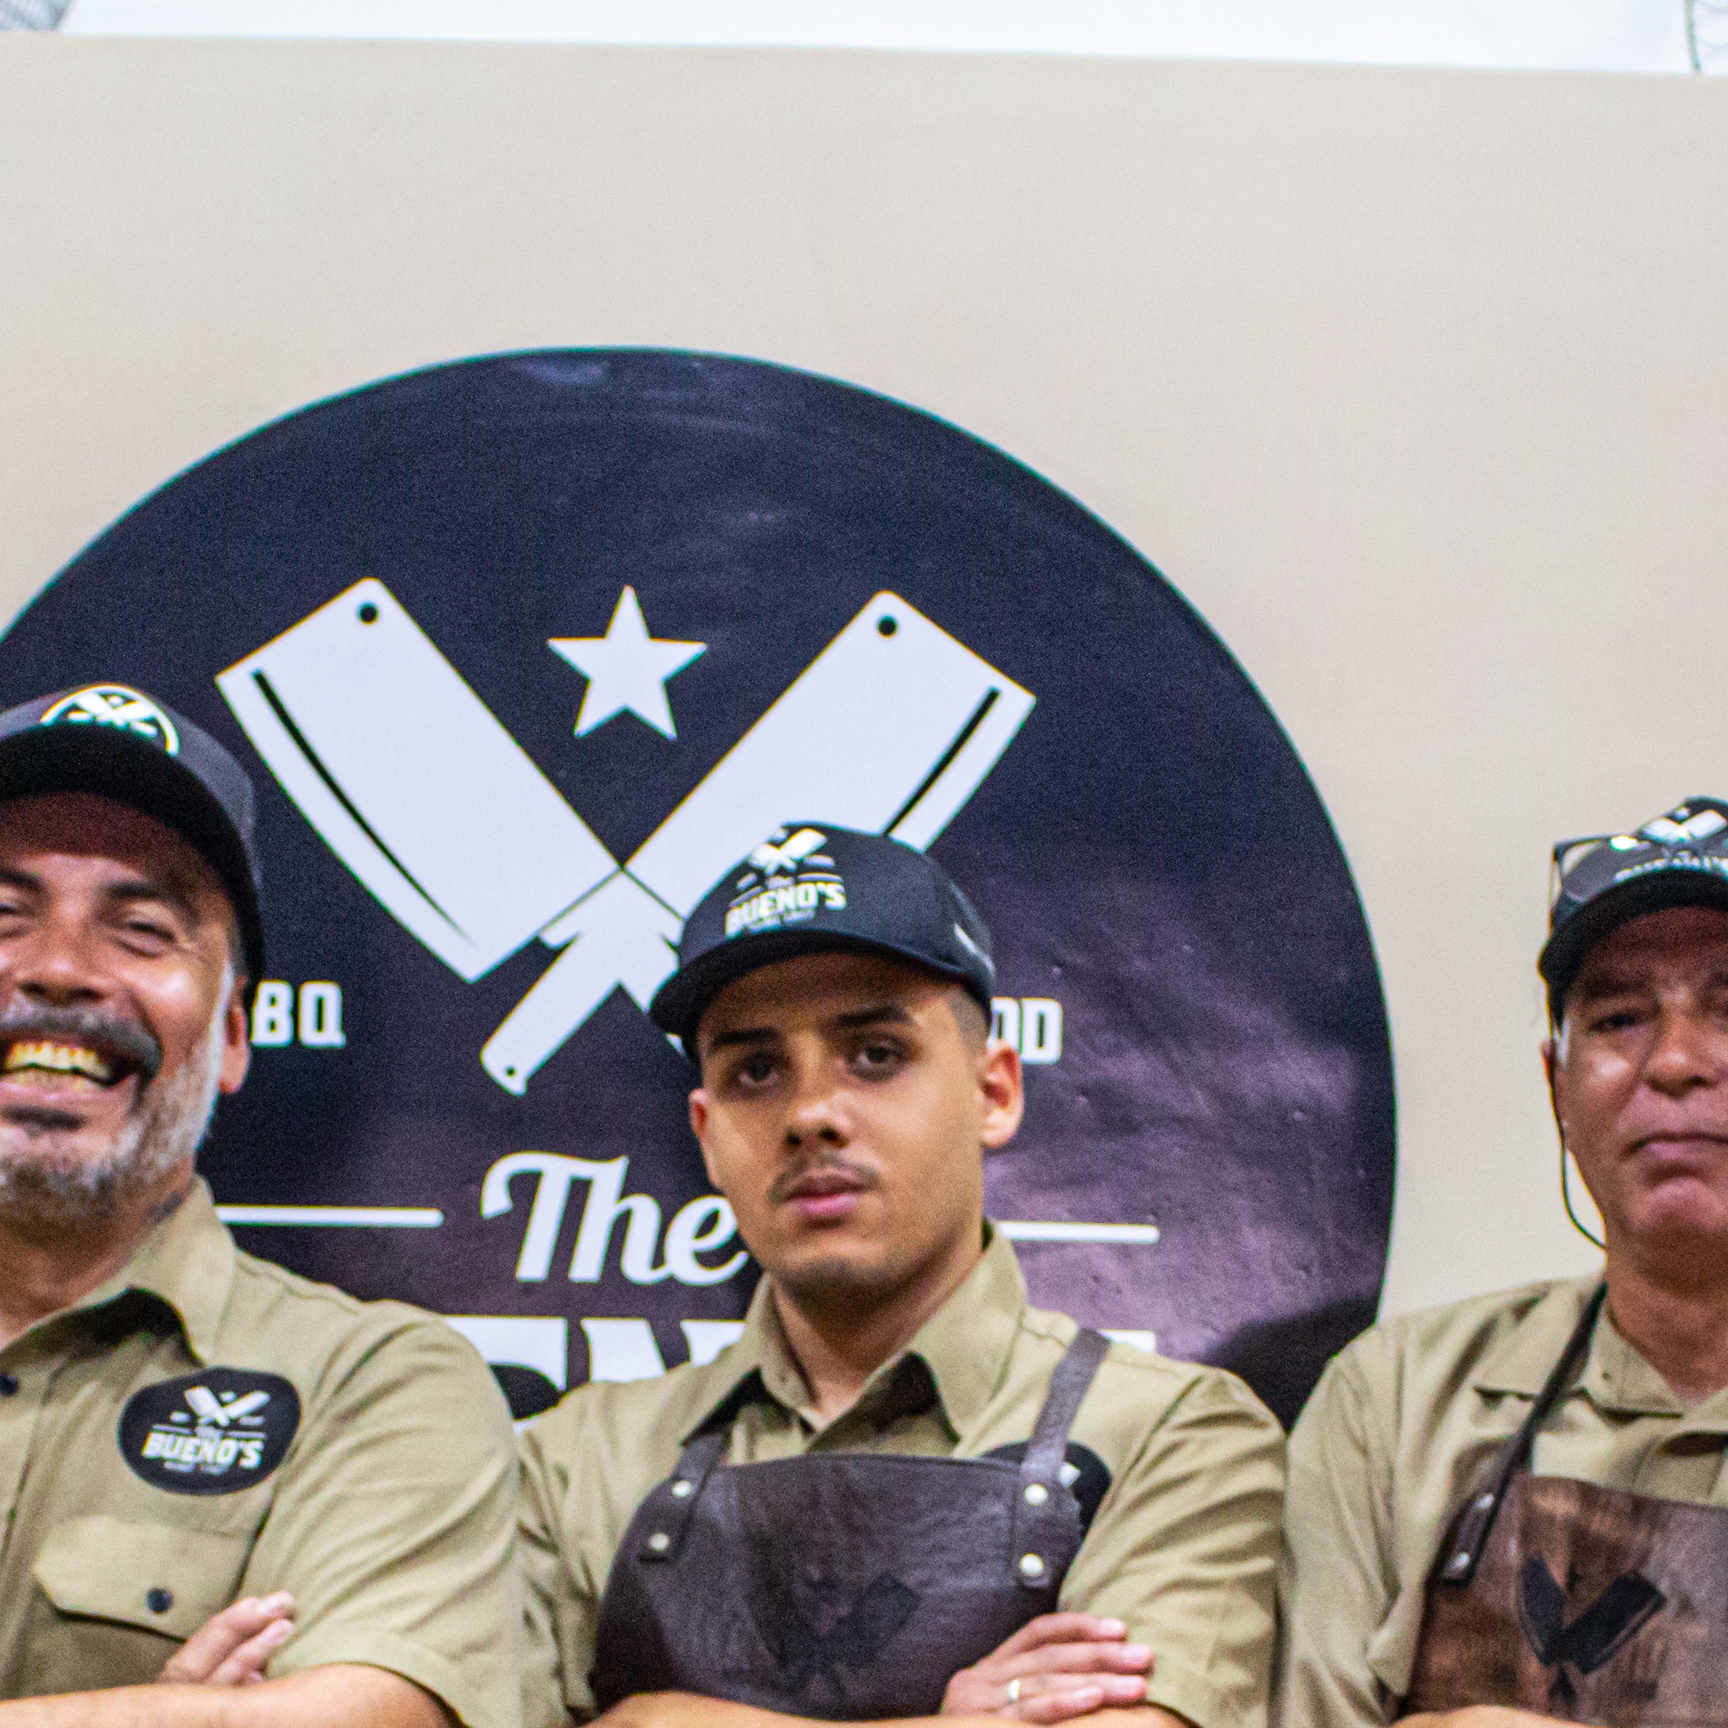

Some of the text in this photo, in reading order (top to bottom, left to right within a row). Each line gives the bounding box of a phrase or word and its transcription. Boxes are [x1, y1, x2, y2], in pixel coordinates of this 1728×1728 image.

[725, 882, 847, 938] BUENO'S
[250, 979, 346, 1048] BQ
[481, 1150, 747, 1286] The
[141, 1431, 265, 1470] BUENO'S
